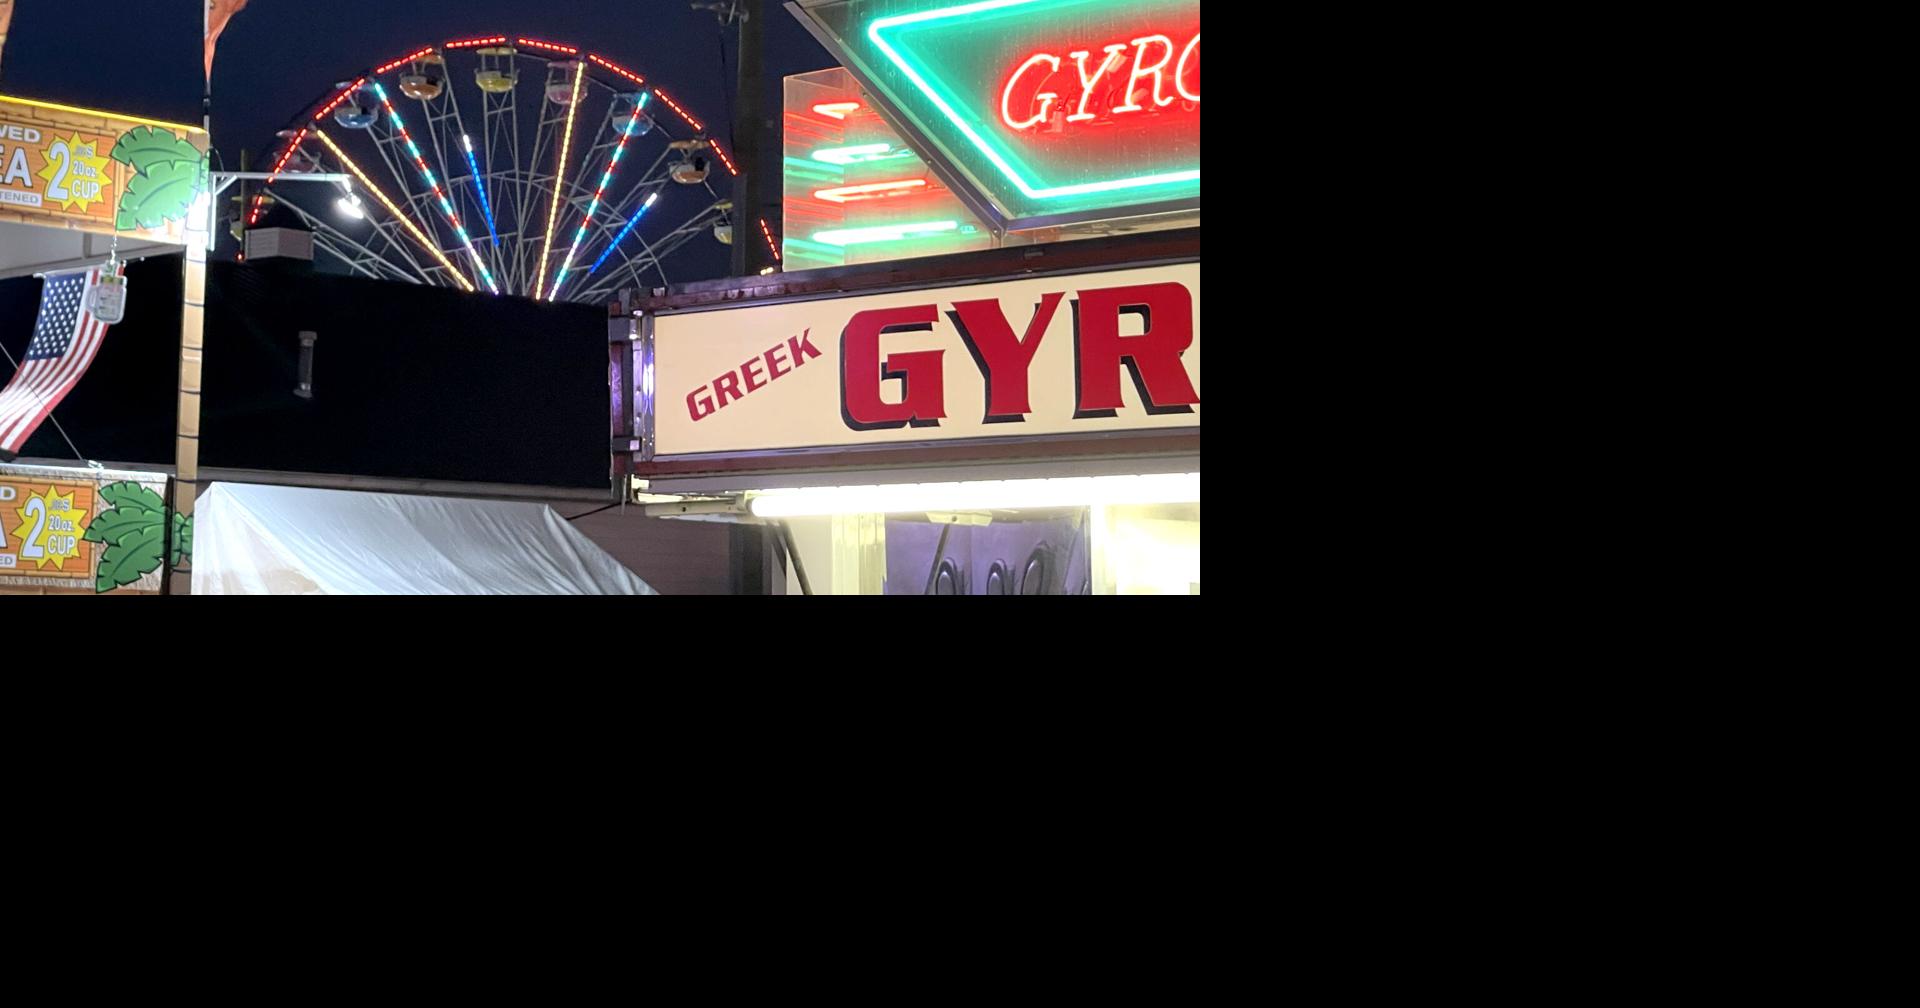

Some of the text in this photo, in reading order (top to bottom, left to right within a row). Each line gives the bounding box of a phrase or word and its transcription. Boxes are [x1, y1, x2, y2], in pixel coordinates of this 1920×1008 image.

[47, 141, 70, 200] 2
[72, 179, 100, 199] CUP
[685, 281, 1200, 431] GREEK GYR
[22, 496, 46, 558] 2
[47, 534, 76, 556] CUP
